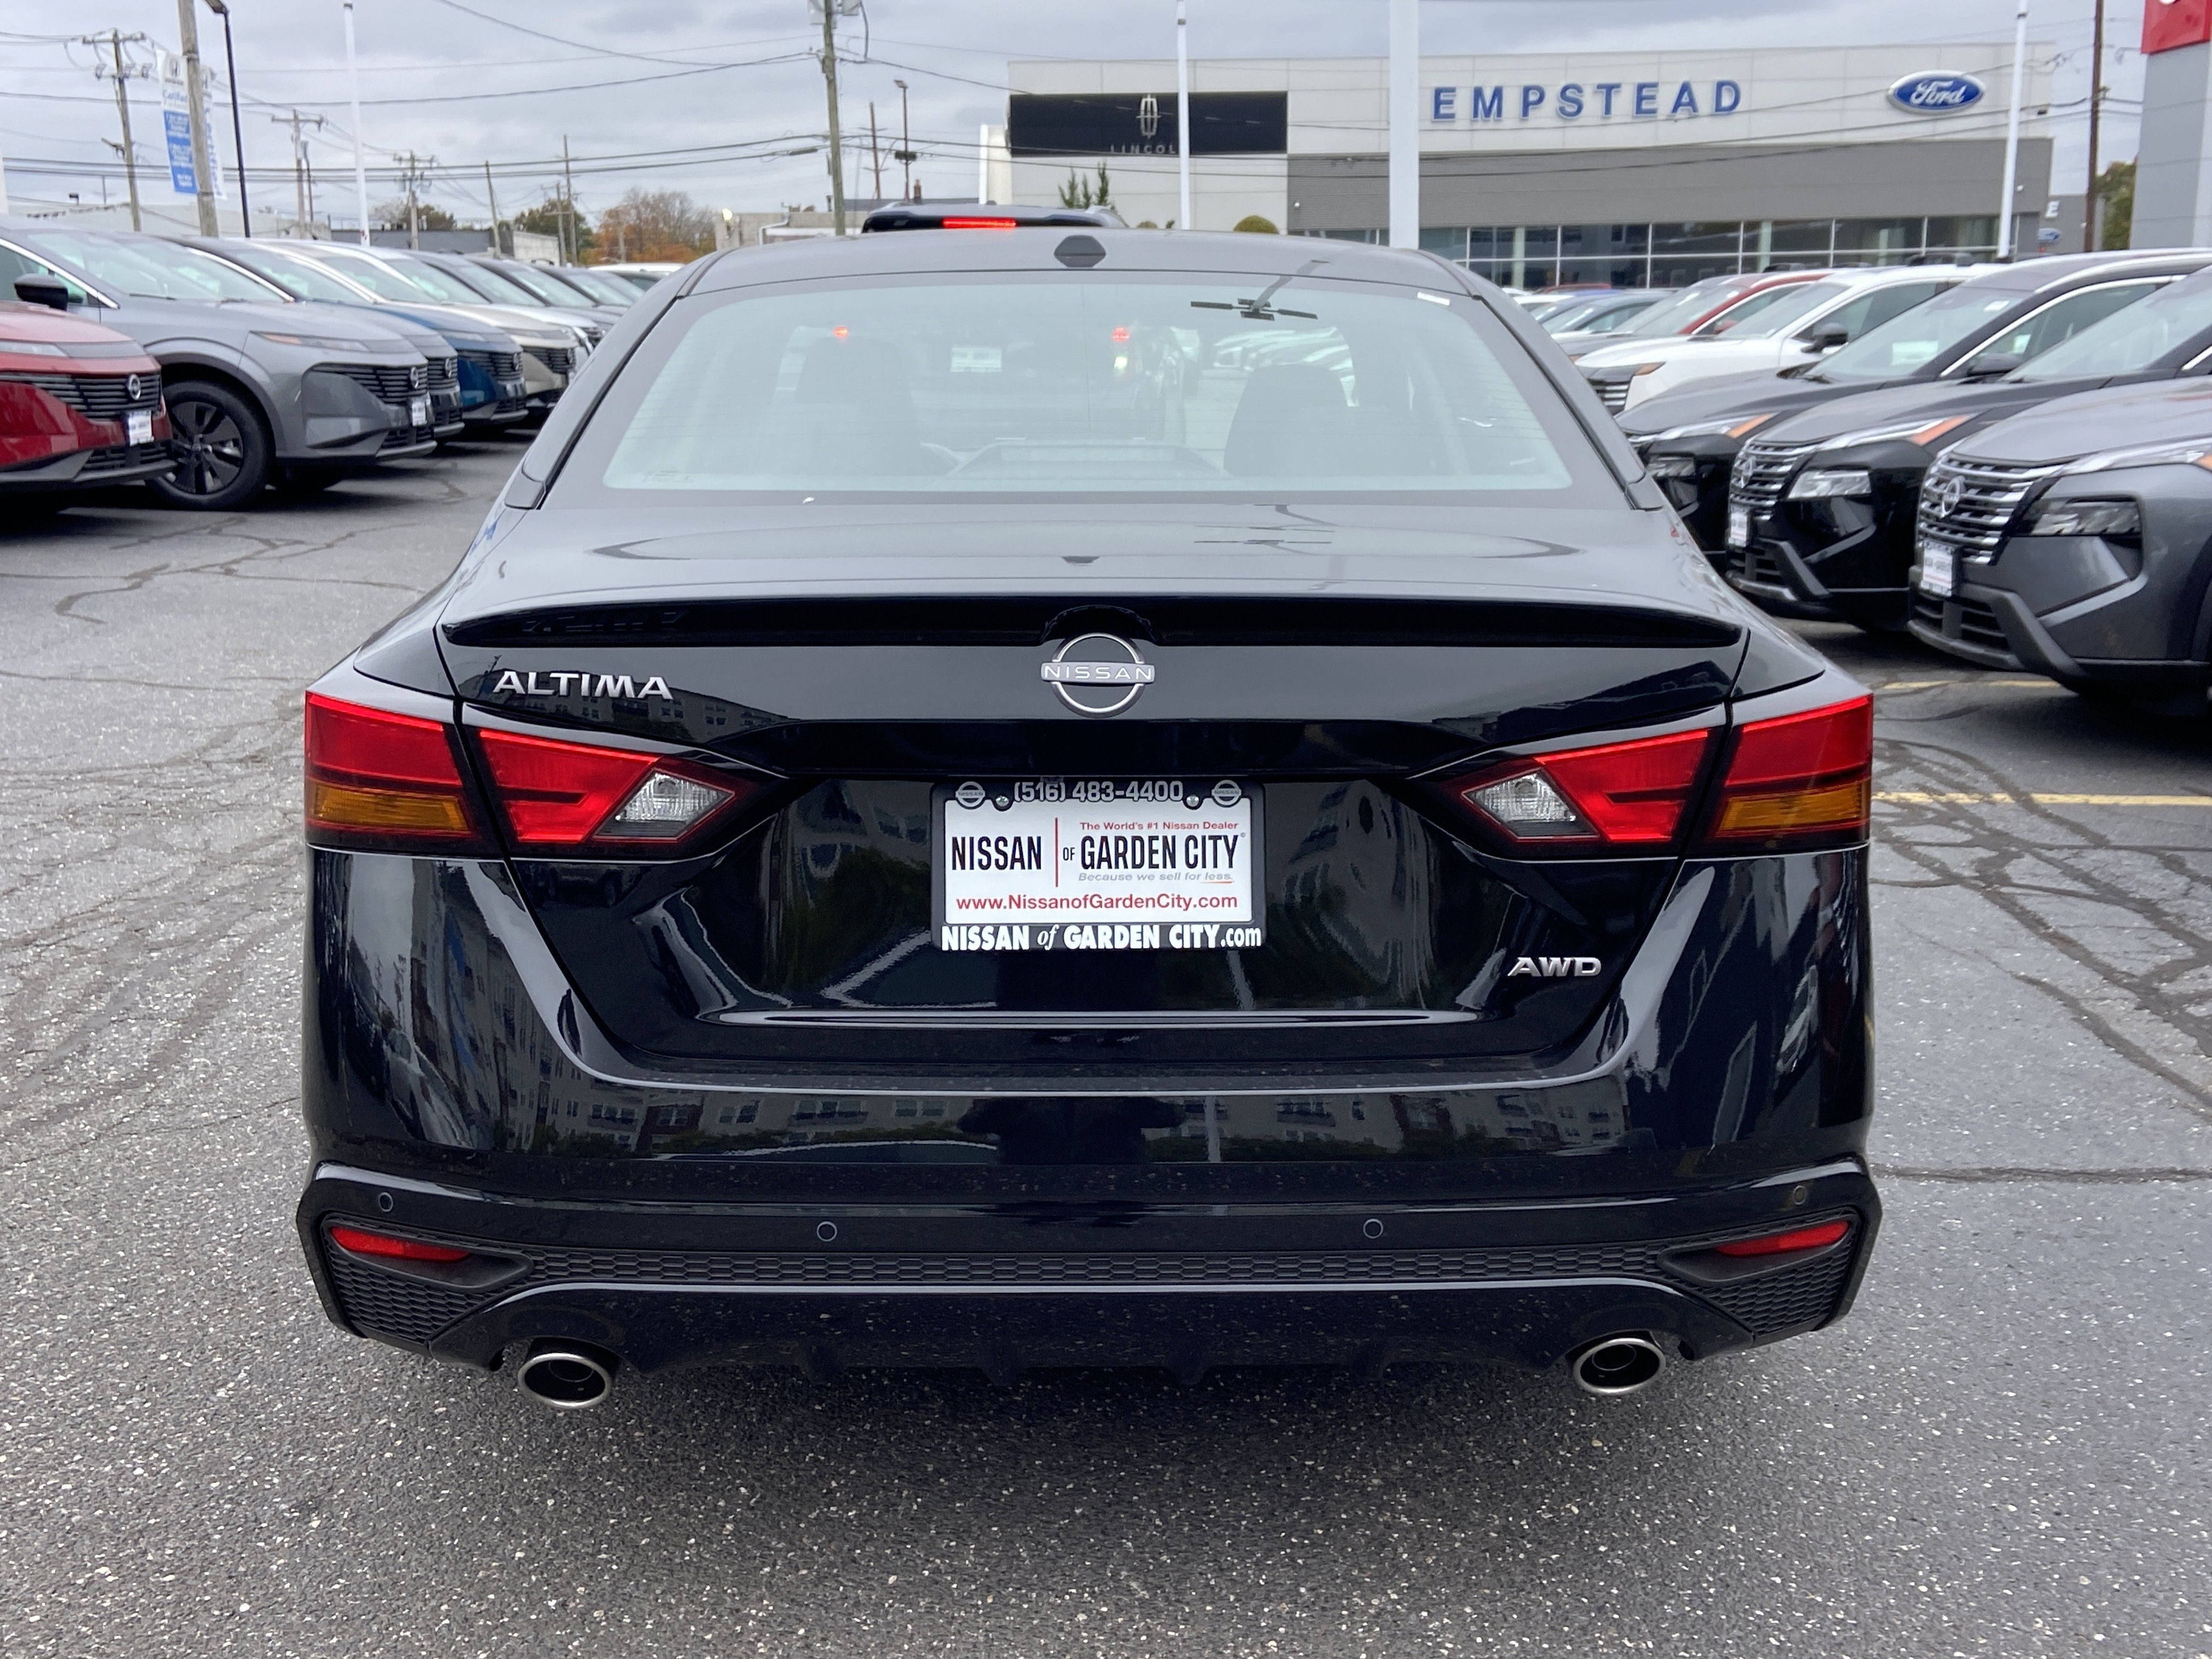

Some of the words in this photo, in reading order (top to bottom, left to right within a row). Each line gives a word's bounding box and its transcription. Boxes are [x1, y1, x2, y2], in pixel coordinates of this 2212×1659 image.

[1434, 80, 1741, 119] EMPSTEAD
[1910, 80, 1967, 105] Ford
[1110, 144, 1176, 155] LINCOL
[1044, 665, 1151, 680] NISSAN
[493, 670, 674, 700] ALTIMA
[1014, 781, 1065, 802] (516)
[1073, 780, 1183, 802] 483-4400
[1080, 822, 1101, 830] The
[1103, 821, 1143, 830] World's
[1147, 822, 1159, 830] #1
[1163, 821, 1199, 830] Nissan
[1203, 821, 1238, 830] Dealer
[951, 836, 1042, 871] NISSAN
[1062, 847, 1075, 861] OF
[1080, 834, 1177, 870] GARDEN
[1184, 834, 1239, 869] CITY
[1079, 872, 1133, 882] Because
[1159, 871, 1181, 881] sell
[1184, 871, 1203, 881] for
[956, 893, 1238, 912] www.NissanofGardenCity.com
[941, 925, 1030, 951] NISSAN
[1037, 923, 1060, 951] of
[1063, 924, 1160, 950] GARDEN
[1507, 956, 1601, 977] AWD
